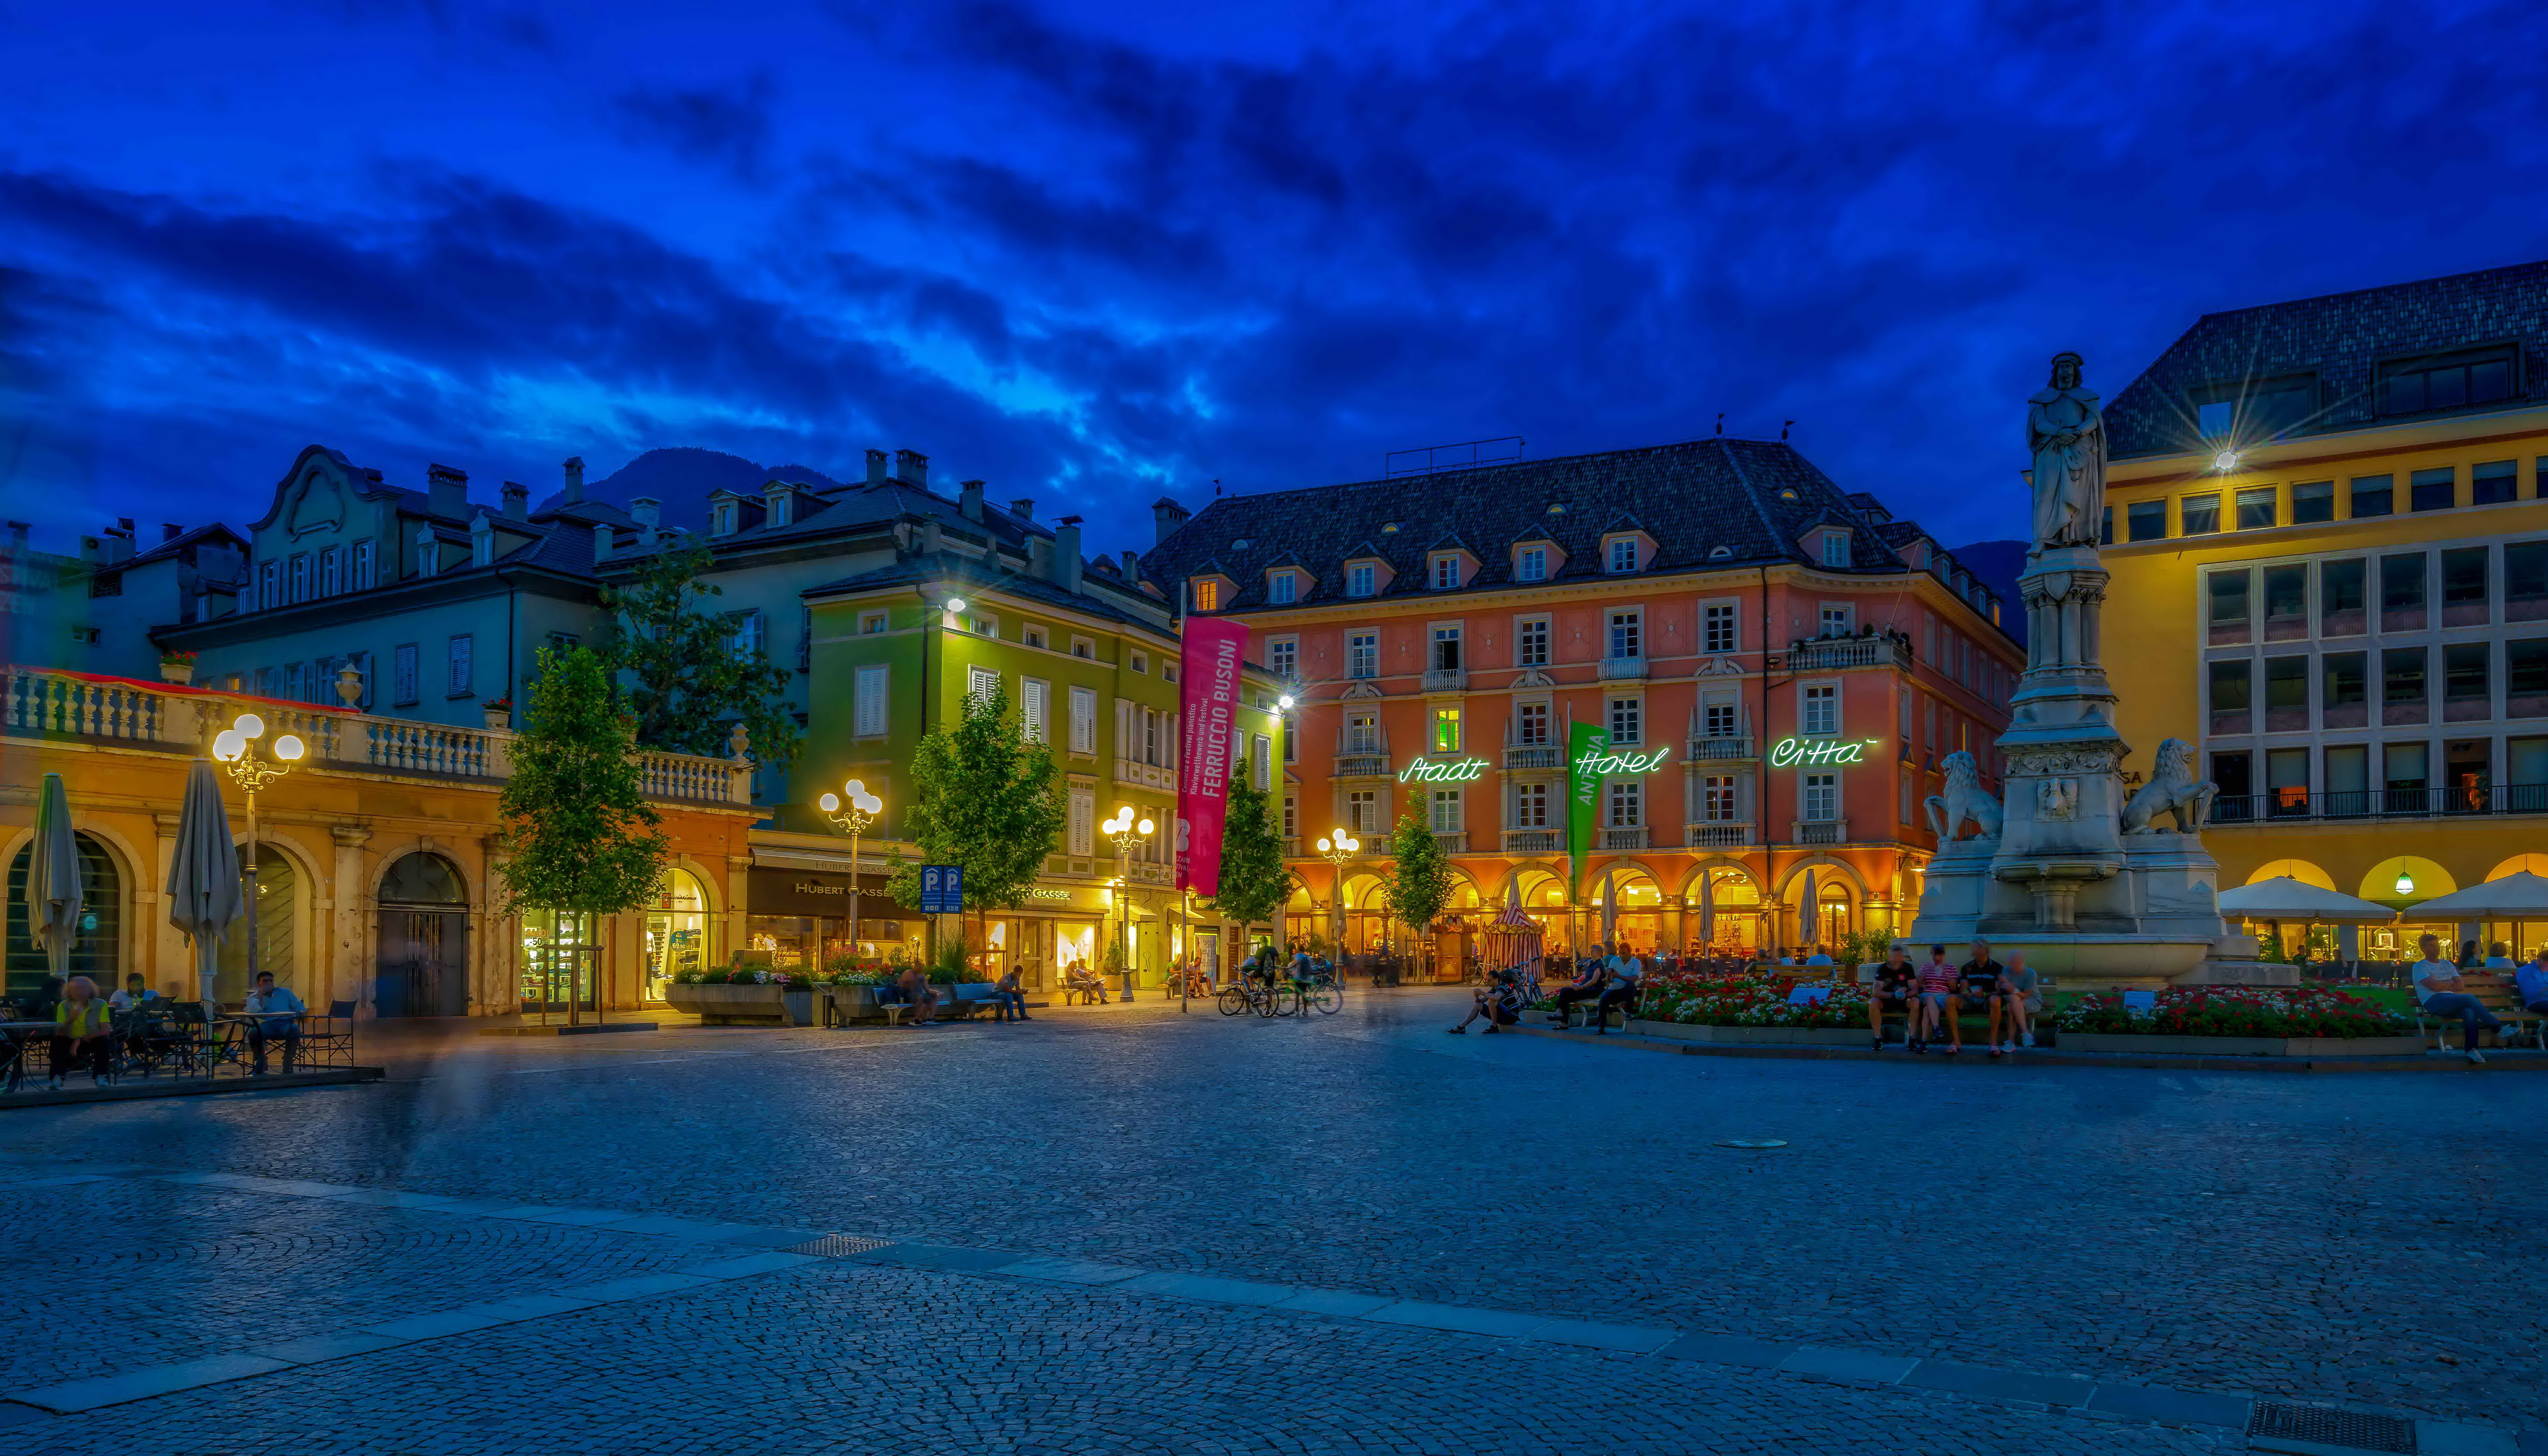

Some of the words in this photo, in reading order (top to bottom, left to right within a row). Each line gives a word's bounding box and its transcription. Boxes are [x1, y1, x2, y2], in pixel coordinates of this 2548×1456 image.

[1213, 639, 1238, 703] BUSONI
[1188, 704, 1196, 733] pianistico
[1190, 736, 1204, 795] Klavierwettbewerb
[1199, 698, 1208, 723] Festival
[1202, 707, 1228, 798] FERRUCCIO
[1400, 757, 1490, 783] Stadt
[1576, 747, 1670, 774] Hotel
[860, 864, 898, 875] GASSER
[795, 883, 844, 895] HUBERT
[926, 873, 938, 891] P
[947, 873, 958, 892] P
[1033, 888, 1073, 900] GASSER
[526, 929, 548, 937] SALDI
